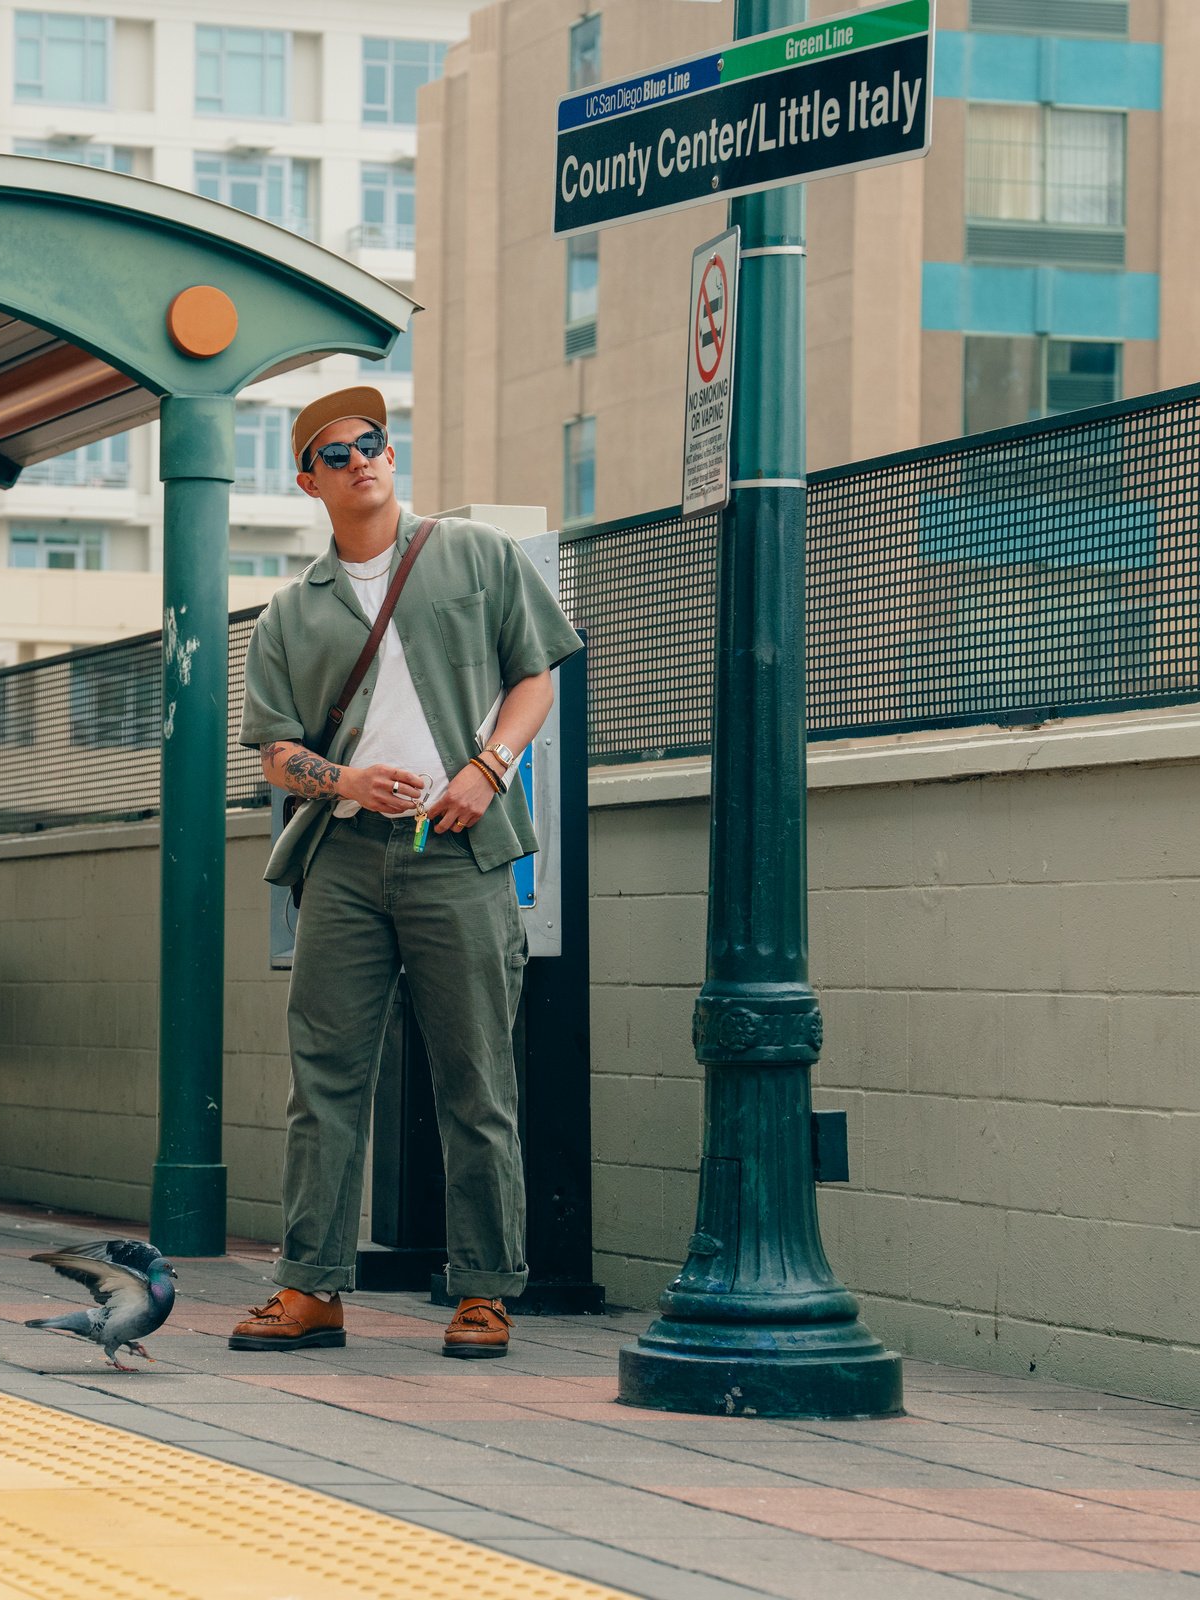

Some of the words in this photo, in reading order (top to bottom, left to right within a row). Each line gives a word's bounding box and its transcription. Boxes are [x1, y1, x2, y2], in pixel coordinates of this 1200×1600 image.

[785, 31, 823, 60] Green
[825, 26, 854, 49] Line
[585, 96, 599, 118] UC
[599, 92, 617, 114] San
[617, 85, 643, 110] Diego
[643, 76, 666, 100] Blue
[668, 71, 690, 94] Line
[561, 142, 652, 197] County
[657, 89, 840, 178] Center/Little
[849, 70, 922, 134] Italy
[688, 391, 697, 412] NO
[699, 378, 728, 407] SMOKING
[691, 413, 700, 432] OR
[701, 403, 724, 428] VAPING
